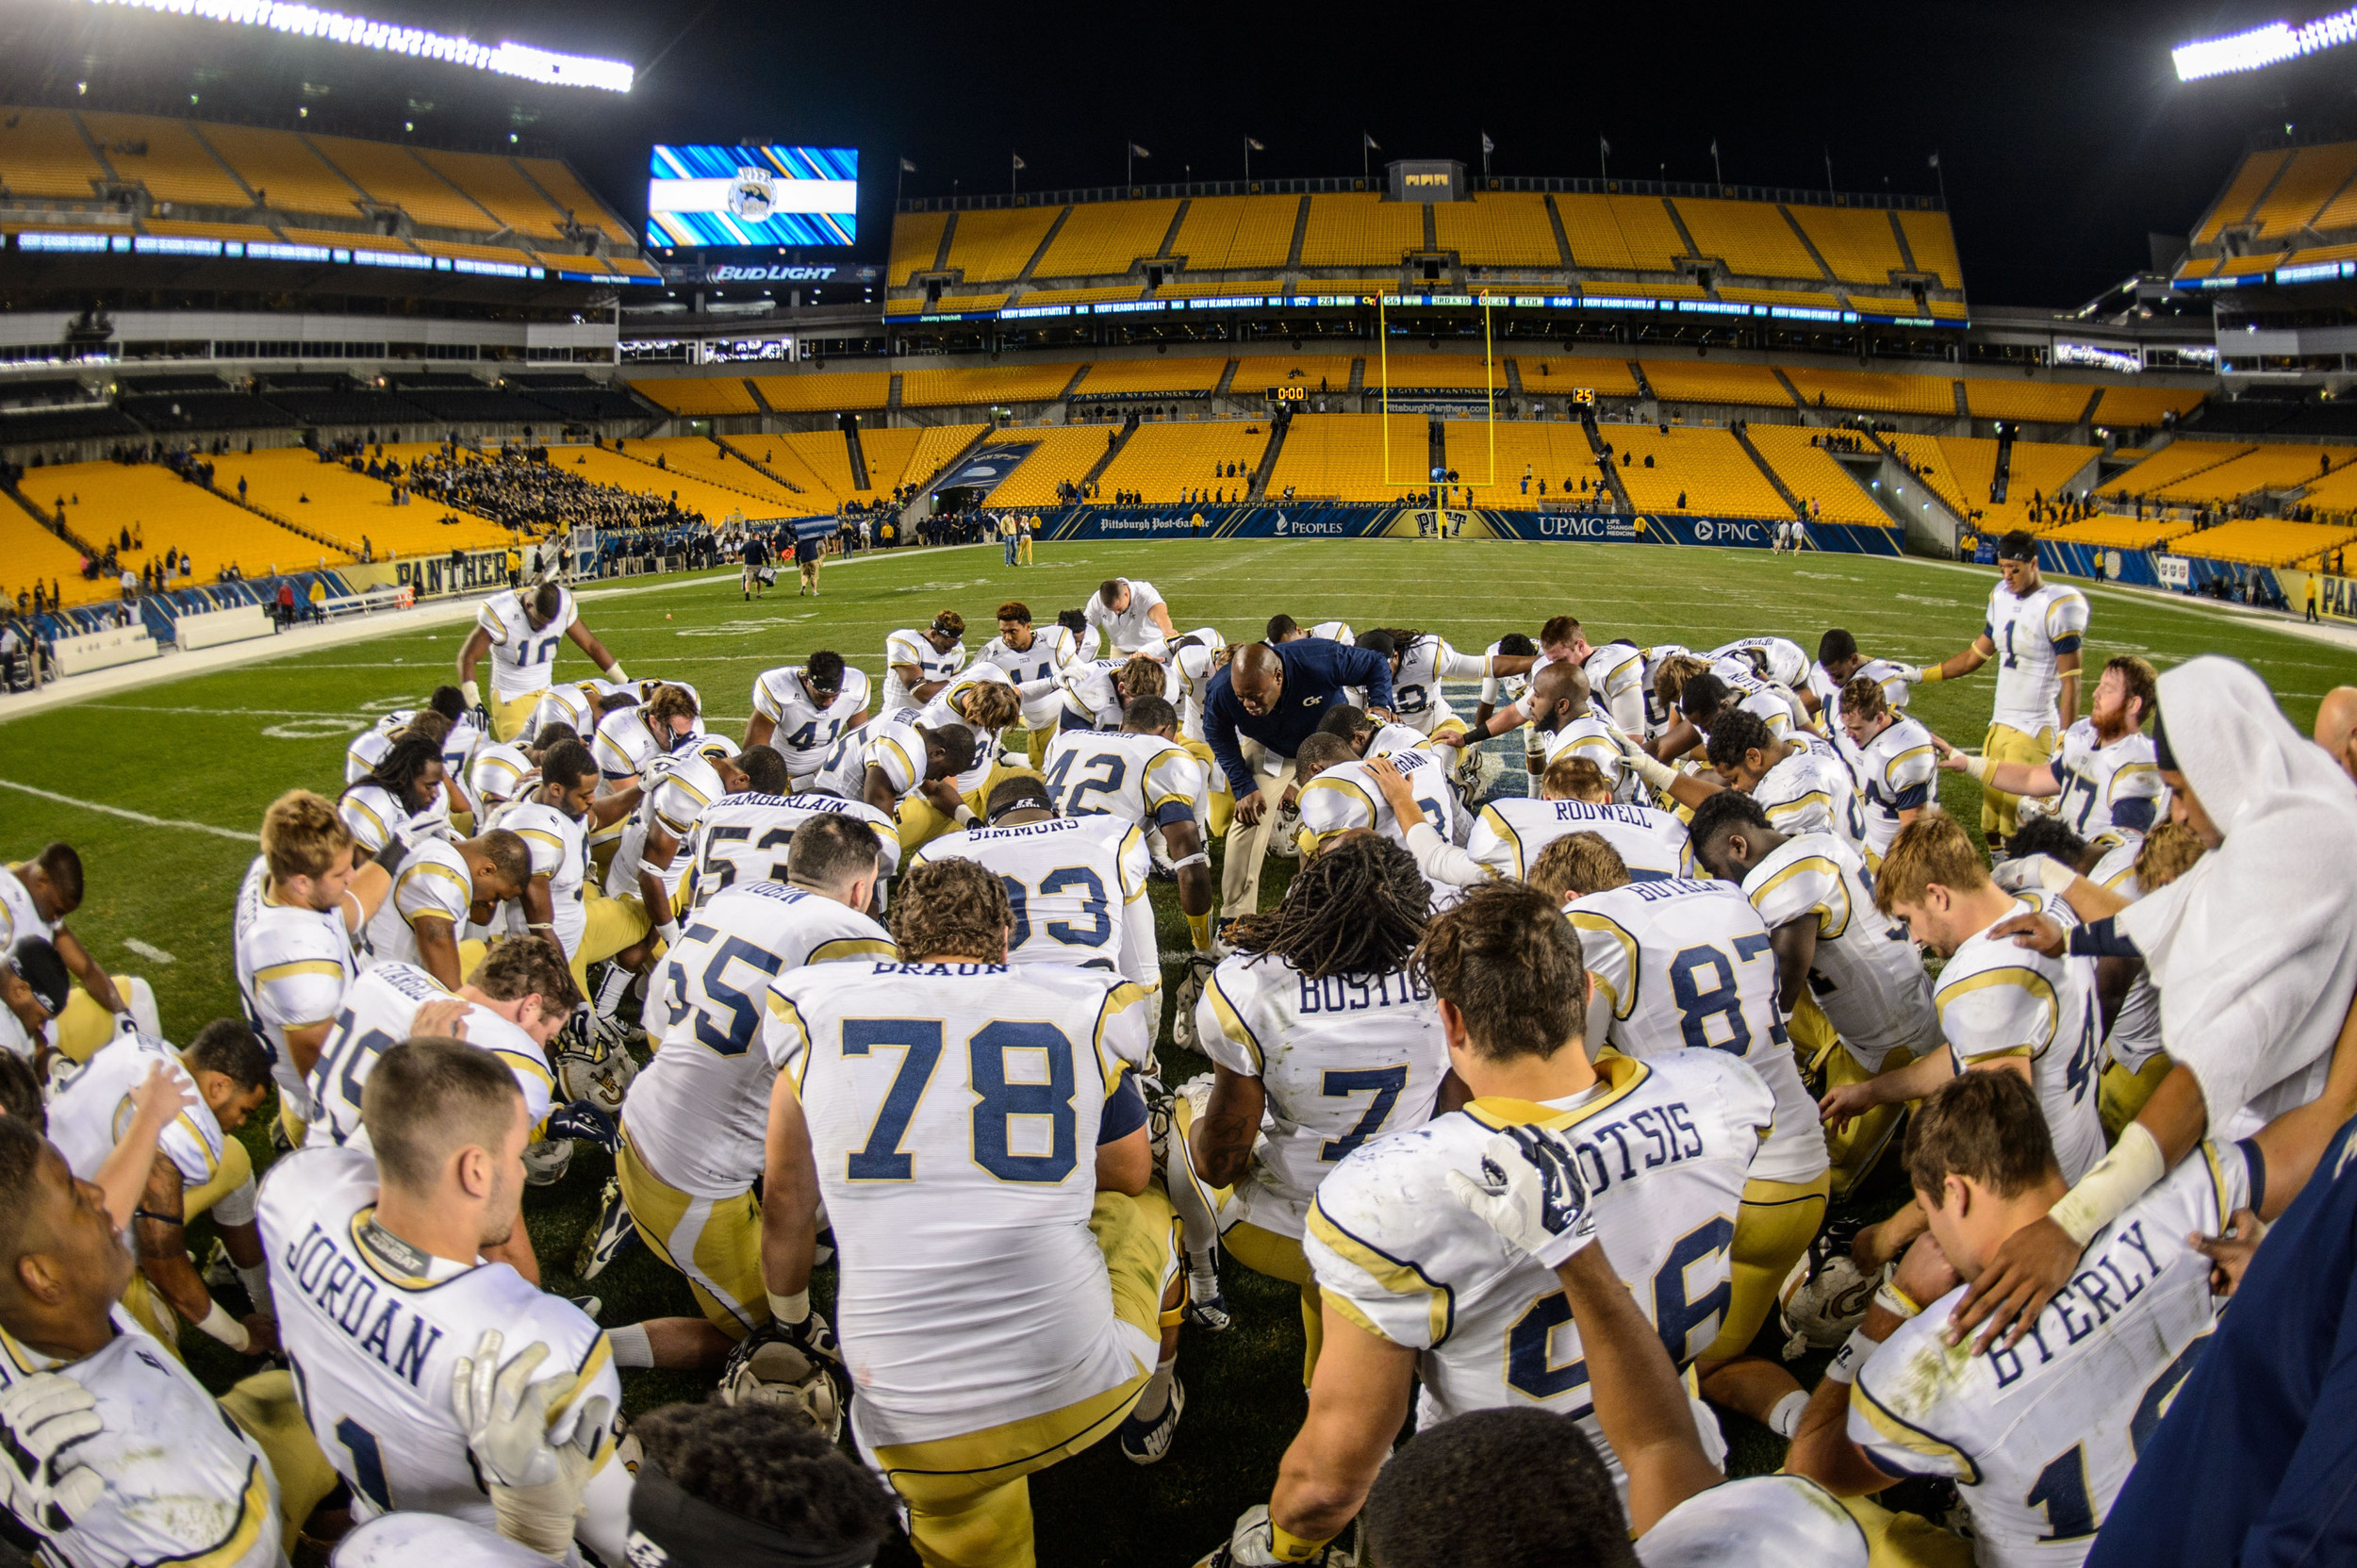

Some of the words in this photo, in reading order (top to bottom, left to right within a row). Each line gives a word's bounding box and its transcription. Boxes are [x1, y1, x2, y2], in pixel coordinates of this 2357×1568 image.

[453, 259, 474, 272] EVERY
[474, 261, 497, 273] SEASON
[497, 263, 519, 276] STARTS
[717, 266, 767, 281] BUD
[766, 265, 836, 281] LIGHT
[1094, 304, 1113, 314] EVERY
[1113, 302, 1135, 313] SEASON
[1135, 301, 1158, 312] STARTS
[1157, 301, 1166, 310] AT
[1190, 298, 1209, 308] EVERY
[1209, 298, 1232, 308] SEASON
[1231, 297, 1255, 307] STARTS
[1255, 297, 1263, 306] AT
[1553, 297, 1573, 306] 0:00
[1583, 298, 1601, 307] EVERY
[1601, 298, 1624, 308] SEASON
[1624, 299, 1647, 309] STARTS
[1647, 300, 1656, 310] AT
[1678, 301, 1697, 311] EVERY
[1697, 302, 1720, 312] SEASON
[1719, 303, 1741, 314] STARTS
[1741, 304, 1751, 315] AT
[1000, 308, 1018, 319] EVERY
[1018, 307, 1041, 319] SEASON
[1041, 306, 1063, 318] STARTS
[1063, 305, 1071, 317] AT
[1772, 306, 1789, 318] EVERY
[1788, 307, 1811, 319] SEASON
[1810, 309, 1832, 321] STARTS
[1832, 310, 1841, 322] AT
[1277, 388, 1304, 400] 0:00
[1576, 388, 1591, 402] 25
[624, 527, 661, 536] PANTHER
[1100, 518, 1150, 532] Pittsburgh
[1291, 521, 1343, 534] PEOPLES
[1415, 511, 1467, 536] PIT
[1539, 517, 1604, 536] UPMC
[1717, 522, 1759, 541] PNC
[396, 551, 522, 596] PANTHER
[2003, 619, 2017, 668] 1
[786, 718, 841, 751] 41
[1046, 750, 1127, 817] 42
[1553, 801, 1653, 830] RODWELL
[969, 817, 1080, 842] SIMMONS
[873, 962, 1010, 977] BRAUN
[665, 922, 787, 1058] 55
[1667, 930, 1791, 1057] 87
[839, 1015, 1080, 1184] 78
[1319, 1061, 1410, 1164] 7
[1576, 1101, 1704, 1197] OTSIS
[367, 1234, 423, 1270] COMBAT
[286, 1221, 443, 1388] JORDAN
[1988, 1219, 2162, 1389] BYERLY
